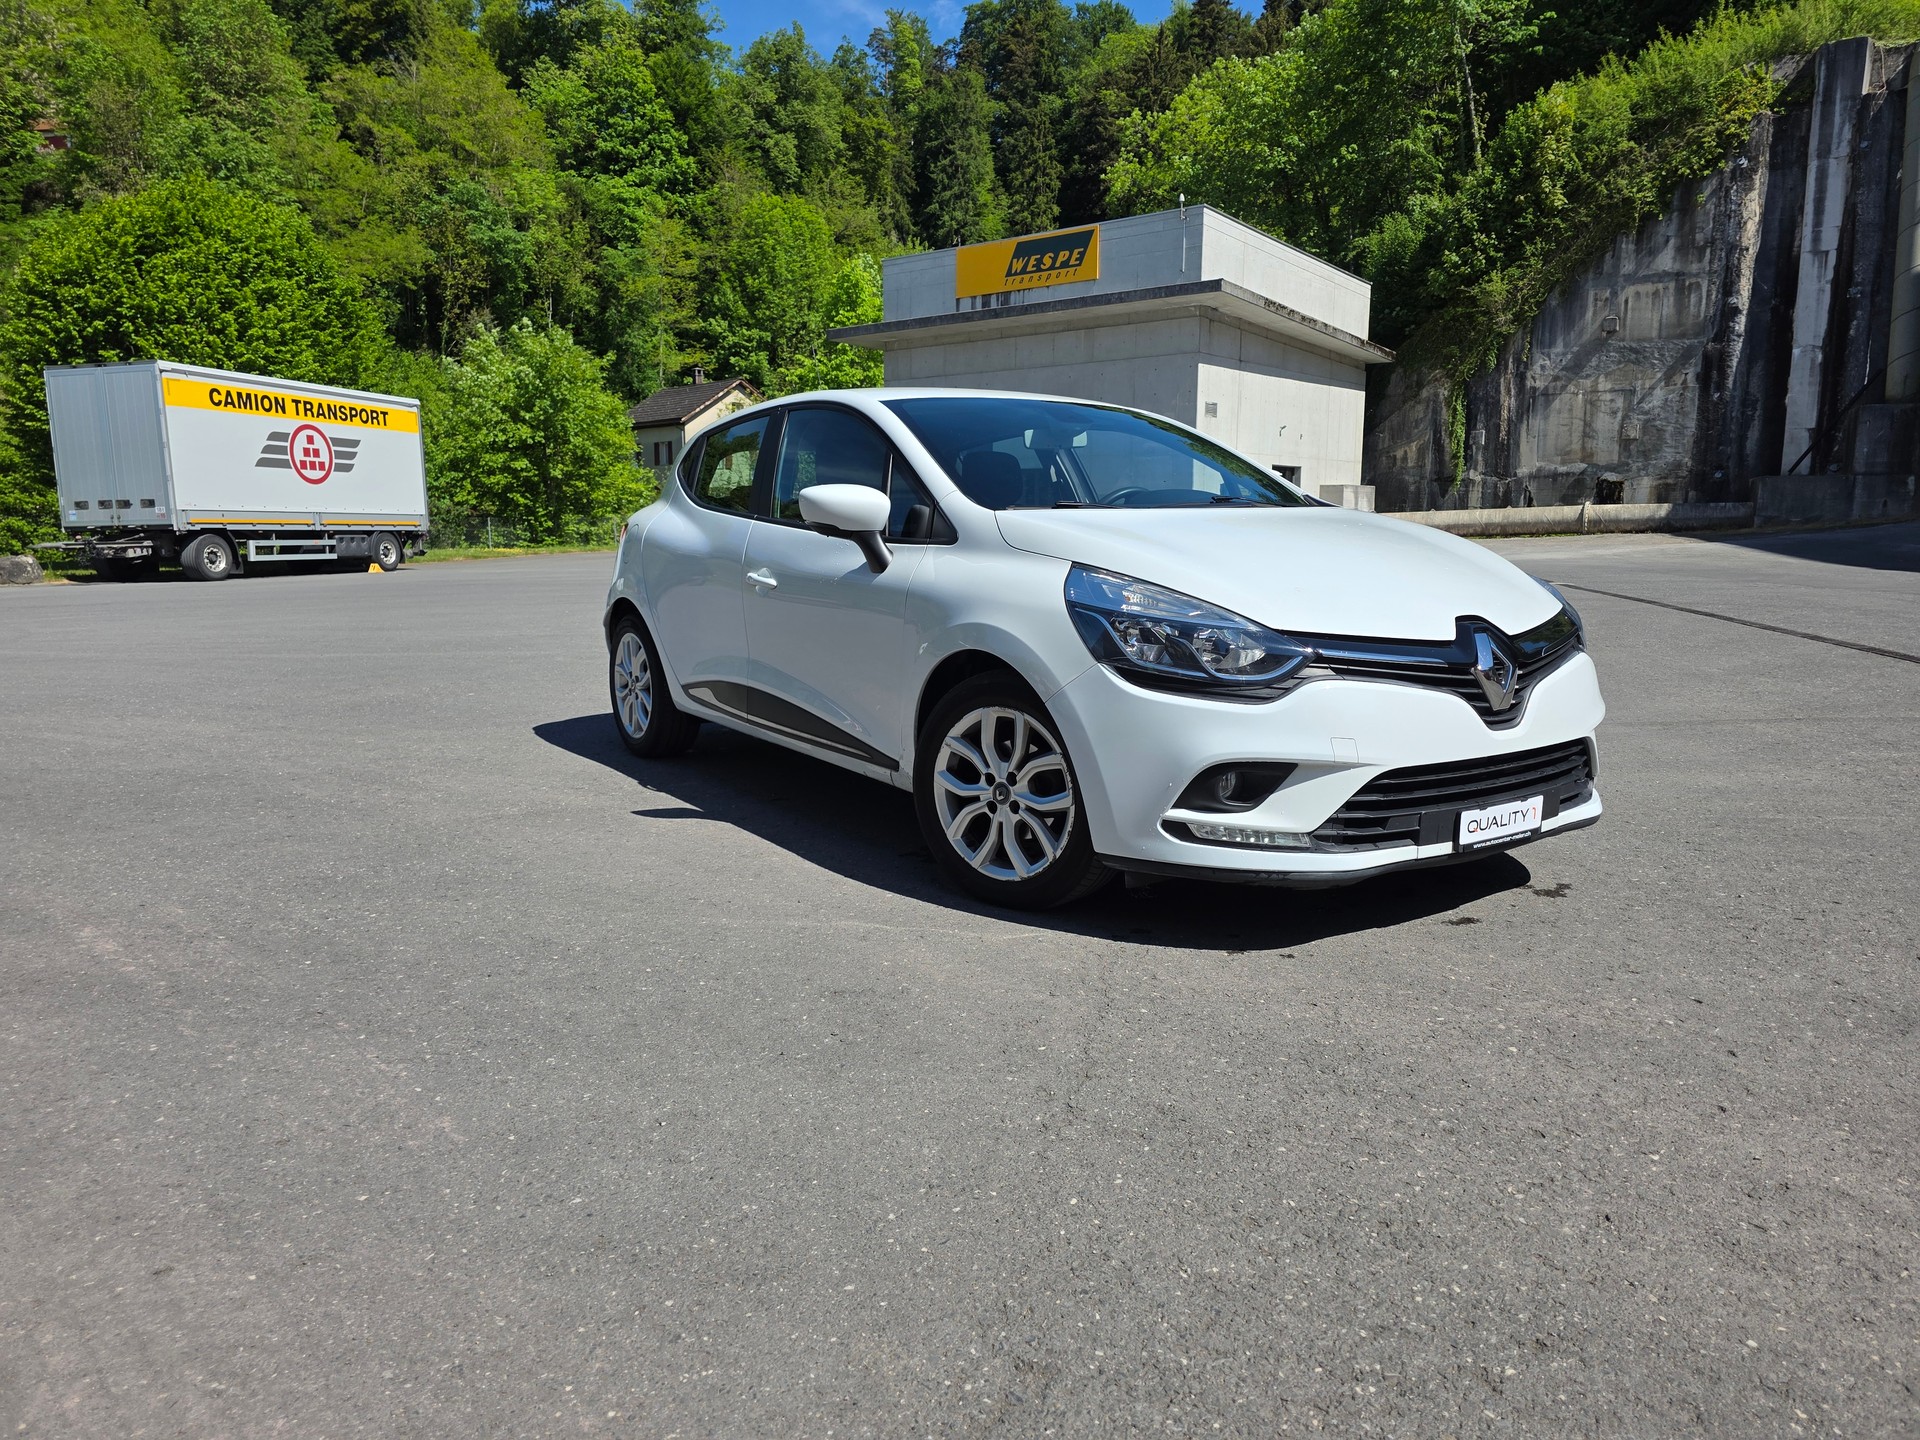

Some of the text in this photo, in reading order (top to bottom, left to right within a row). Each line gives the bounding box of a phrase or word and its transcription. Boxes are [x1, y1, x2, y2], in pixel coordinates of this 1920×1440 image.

[1011, 247, 1084, 274] WESPE
[1004, 268, 1078, 286] transport
[209, 387, 389, 427] CAMION TRANSPORT
